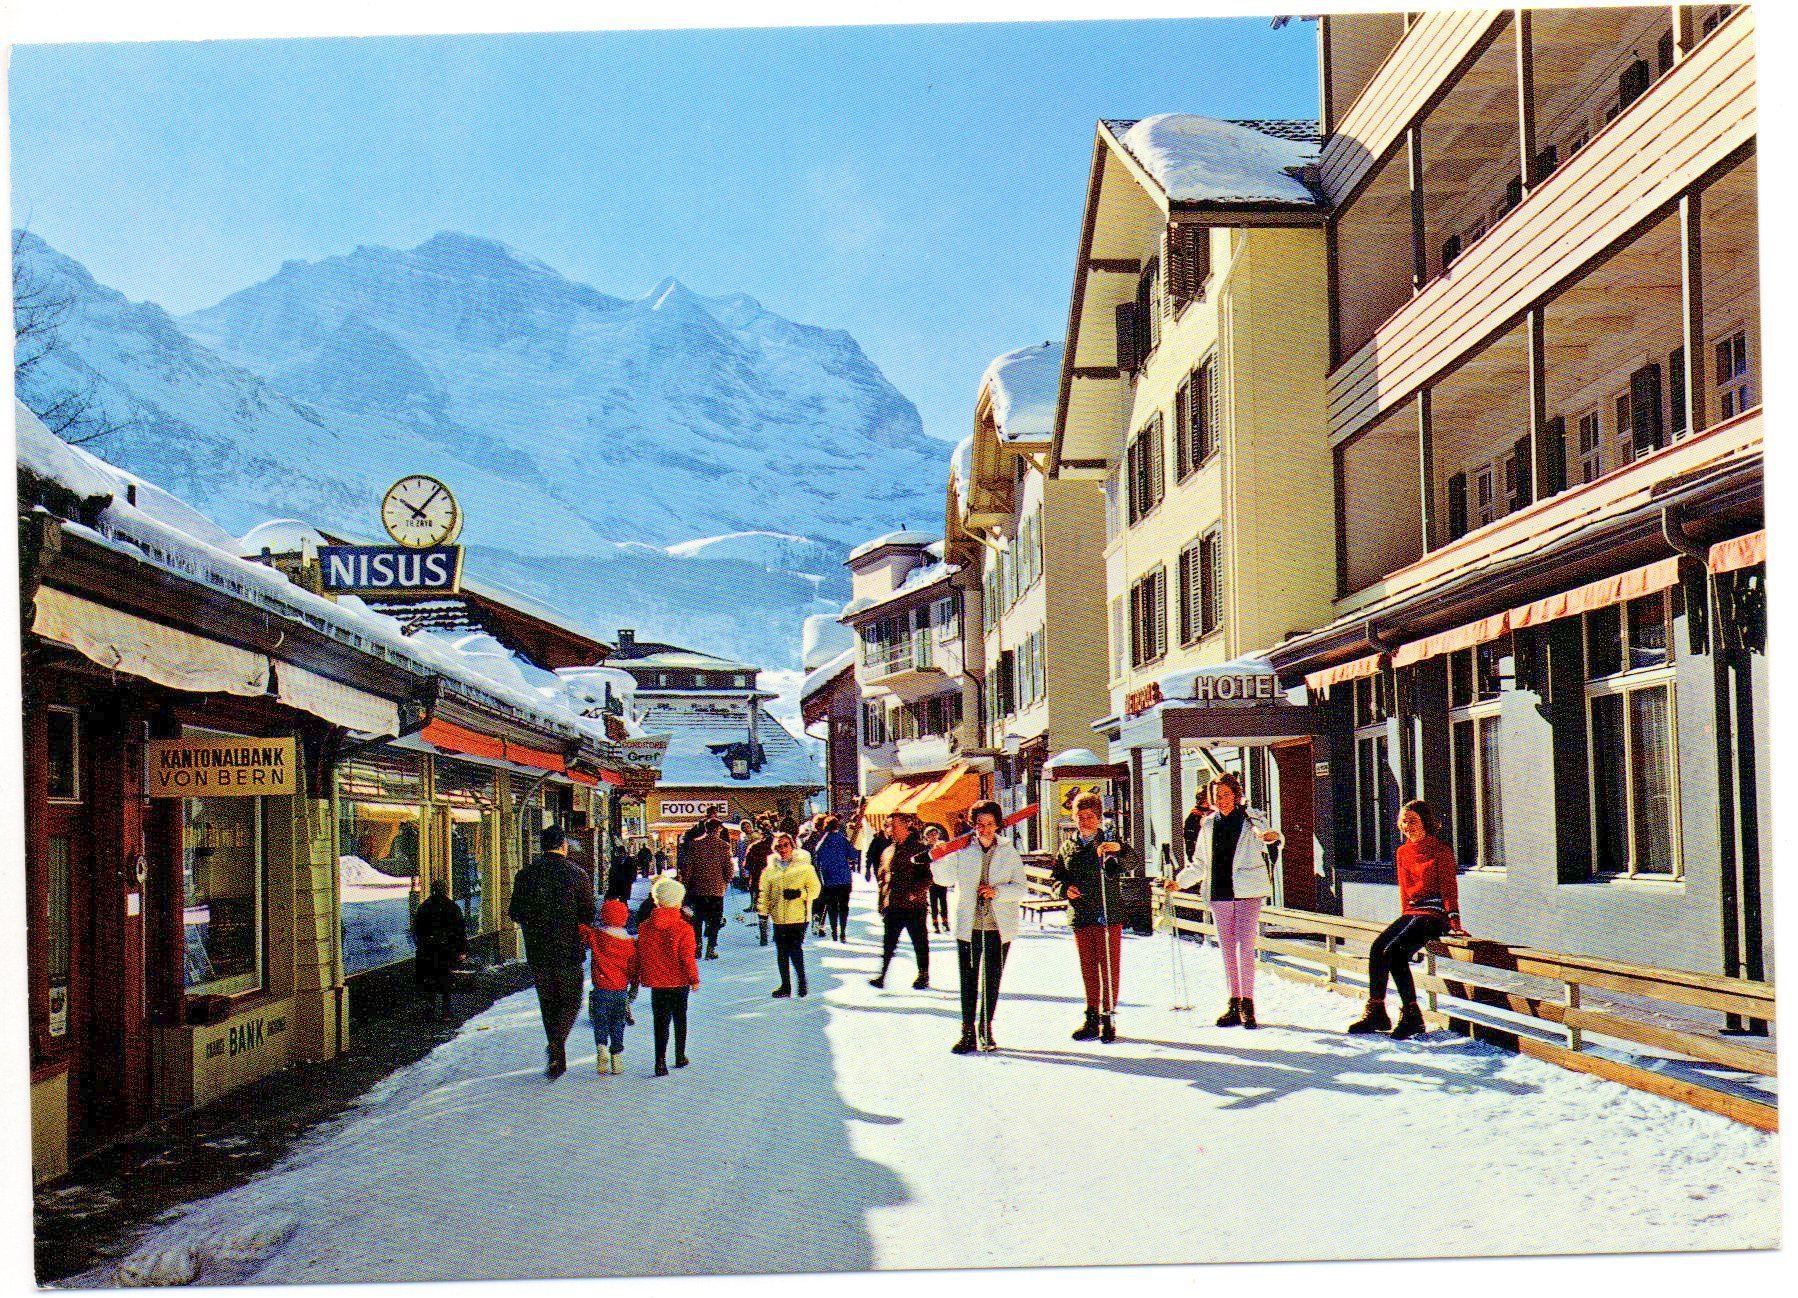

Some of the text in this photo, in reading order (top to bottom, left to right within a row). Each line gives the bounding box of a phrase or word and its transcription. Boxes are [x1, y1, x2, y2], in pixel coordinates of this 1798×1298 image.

[329, 553, 447, 587] NISUS
[1194, 675, 1288, 700] HOTEL
[160, 747, 284, 768] KANTONALBANK
[159, 768, 284, 787] VON BERN
[662, 803, 695, 814] FOTO
[229, 1017, 264, 1057] BANK
